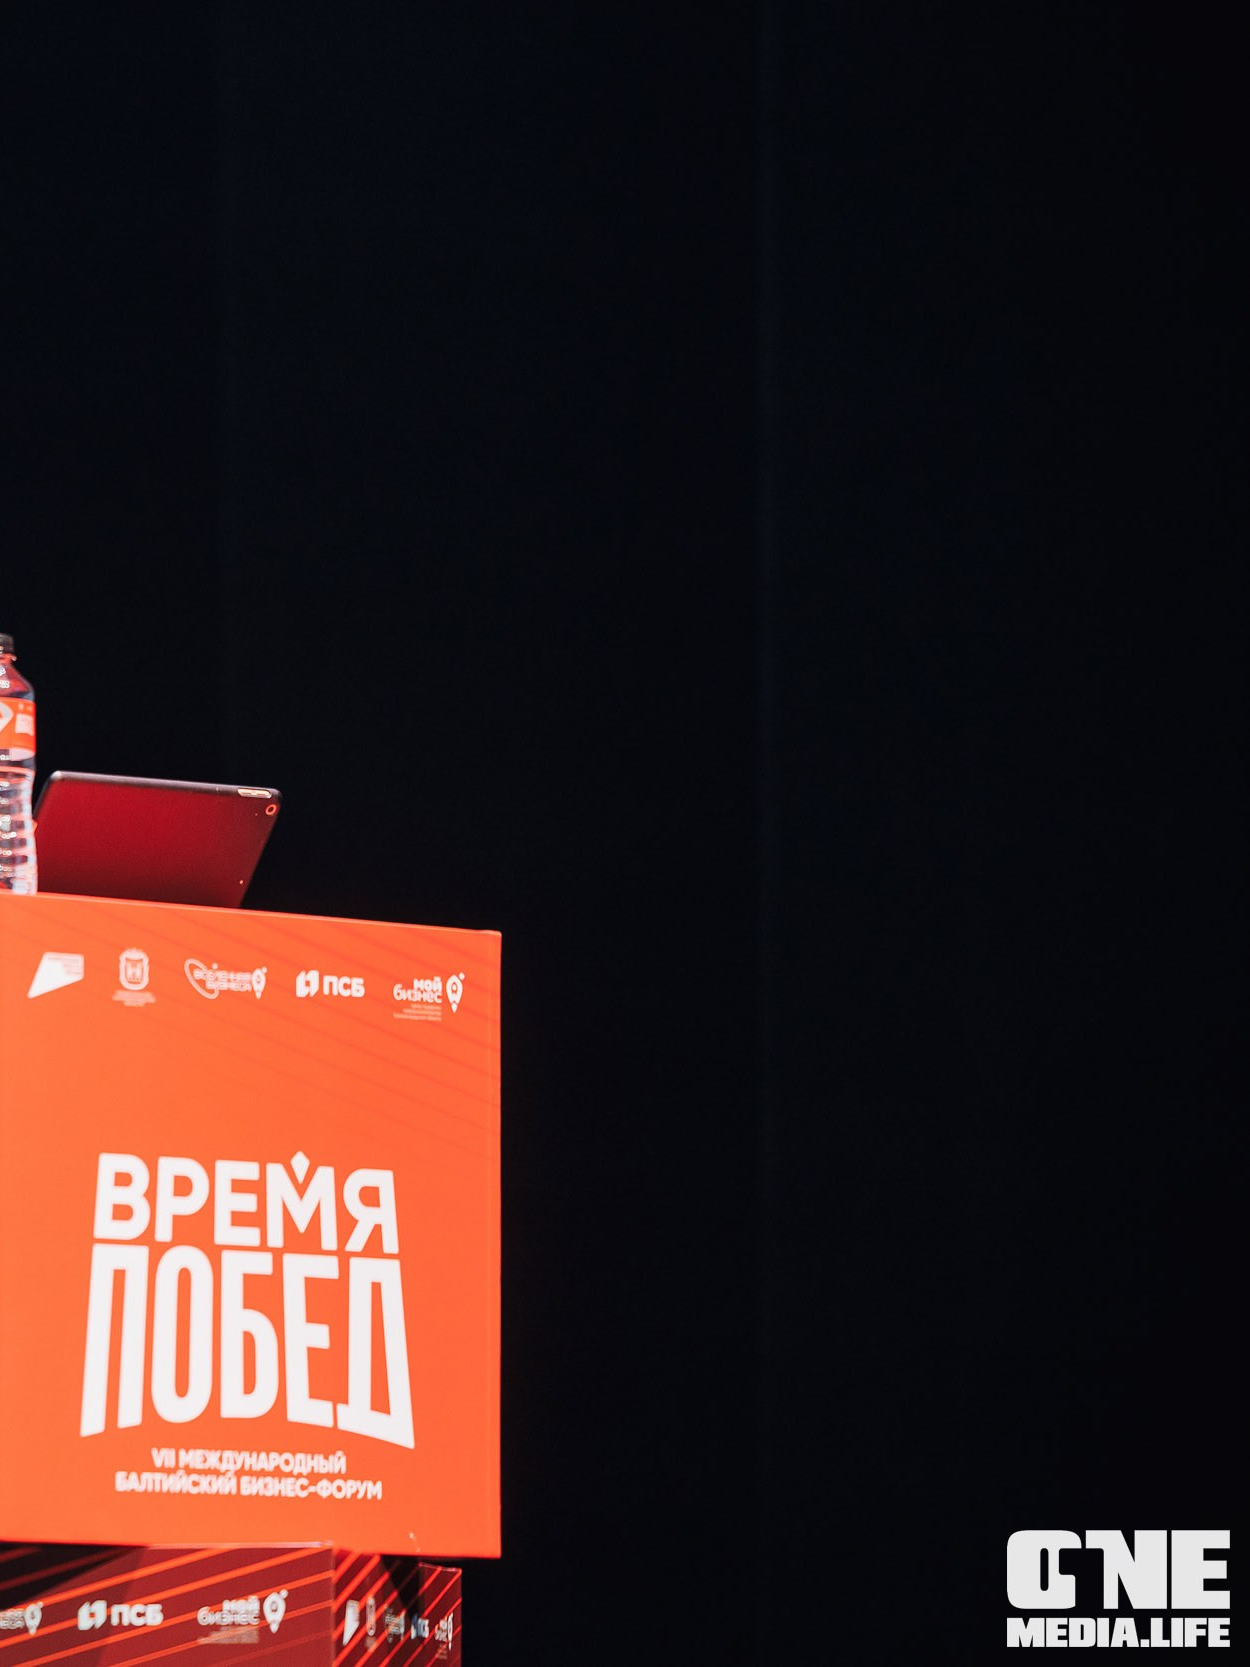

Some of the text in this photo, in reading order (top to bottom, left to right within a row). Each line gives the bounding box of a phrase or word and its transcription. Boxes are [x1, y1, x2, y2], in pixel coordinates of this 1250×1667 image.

[323, 975, 365, 998] ПСБ
[393, 984, 442, 1004] бизнес
[413, 976, 442, 994] мой
[93, 1150, 399, 1254] ВРЕМЯ
[80, 1243, 415, 1449] ПОБЕД
[151, 1448, 346, 1475] VII МЕЖДУНАРОДНЫЙ
[115, 1471, 382, 1500] БАЛТИЙСКИЙ БИЗНЕС-ФОРУМ
[111, 1604, 164, 1627] ПСБ
[197, 1606, 260, 1626] бизнес
